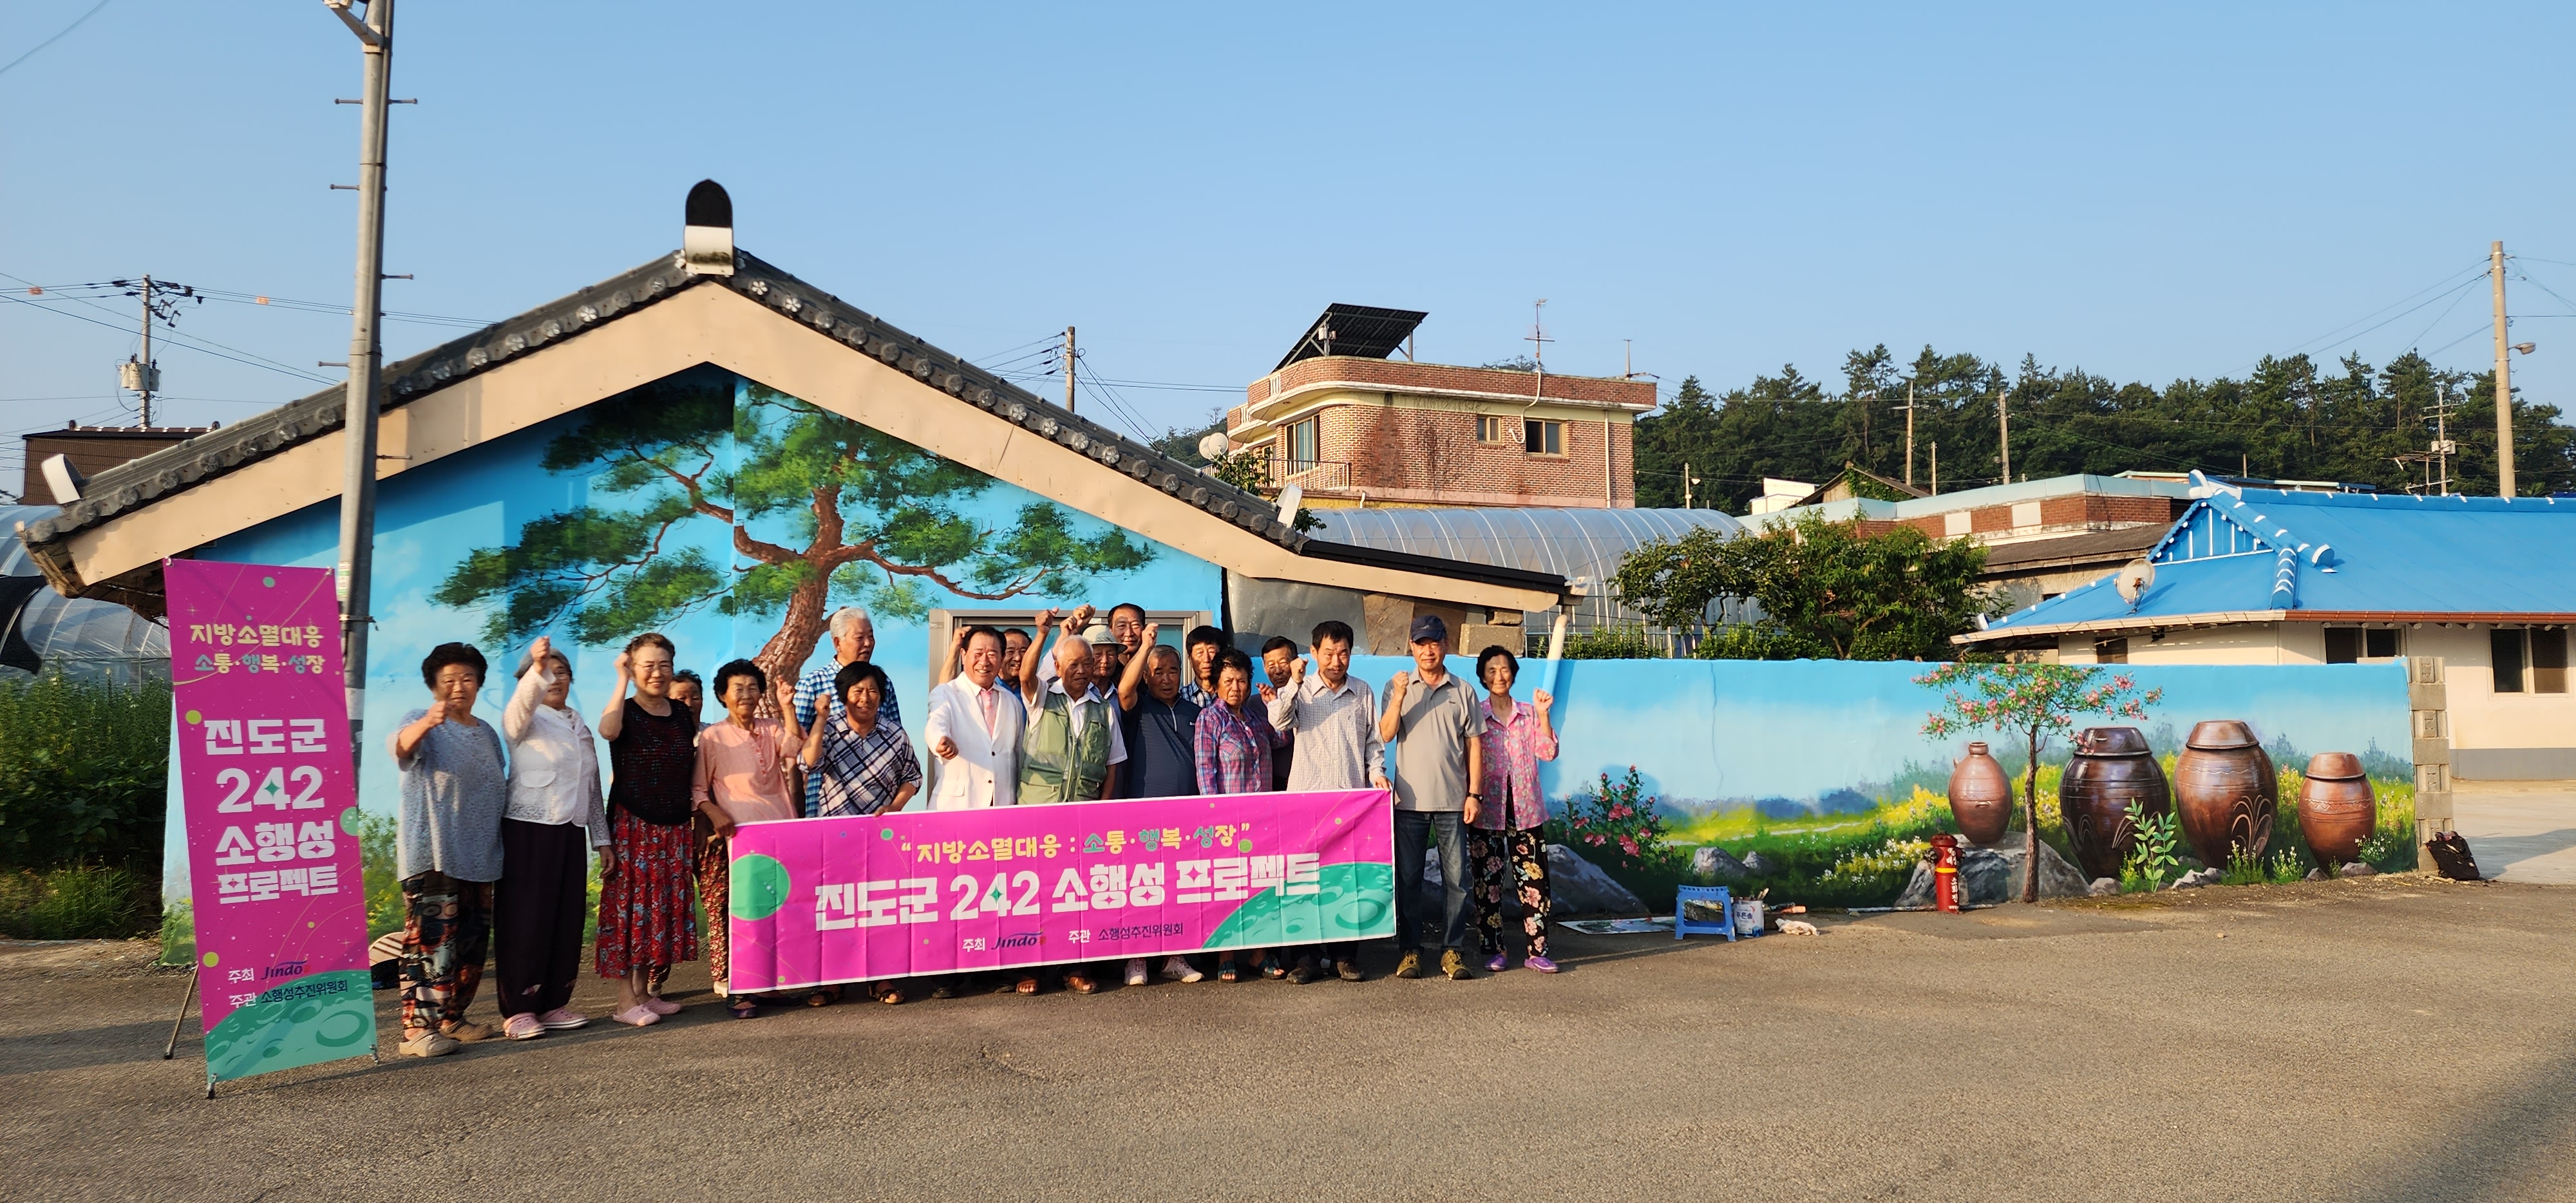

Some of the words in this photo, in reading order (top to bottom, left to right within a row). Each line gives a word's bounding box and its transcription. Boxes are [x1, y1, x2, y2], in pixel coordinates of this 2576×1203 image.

[190, 623, 325, 648] 지방소멸대응
[194, 653, 326, 674] 소통·행복·성장
[204, 719, 327, 755] 진도군
[217, 765, 325, 813] 242
[214, 820, 336, 866] 소행성
[218, 866, 338, 904] 프로젝트
[815, 877, 938, 931] 진도군
[950, 870, 1040, 921] 242
[1052, 862, 1164, 913] 소행성
[1176, 853, 1320, 904] 프로젝트
[963, 938, 985, 952] 주최
[991, 933, 1037, 951] Jindo
[1068, 930, 1090, 943] 주관
[1098, 922, 1183, 941] 소행성추진위원회
[229, 968, 254, 983] 주최
[261, 964, 303, 980] Jindo
[229, 992, 257, 1009] 주관
[261, 980, 348, 1003] 소행성추진위원회
